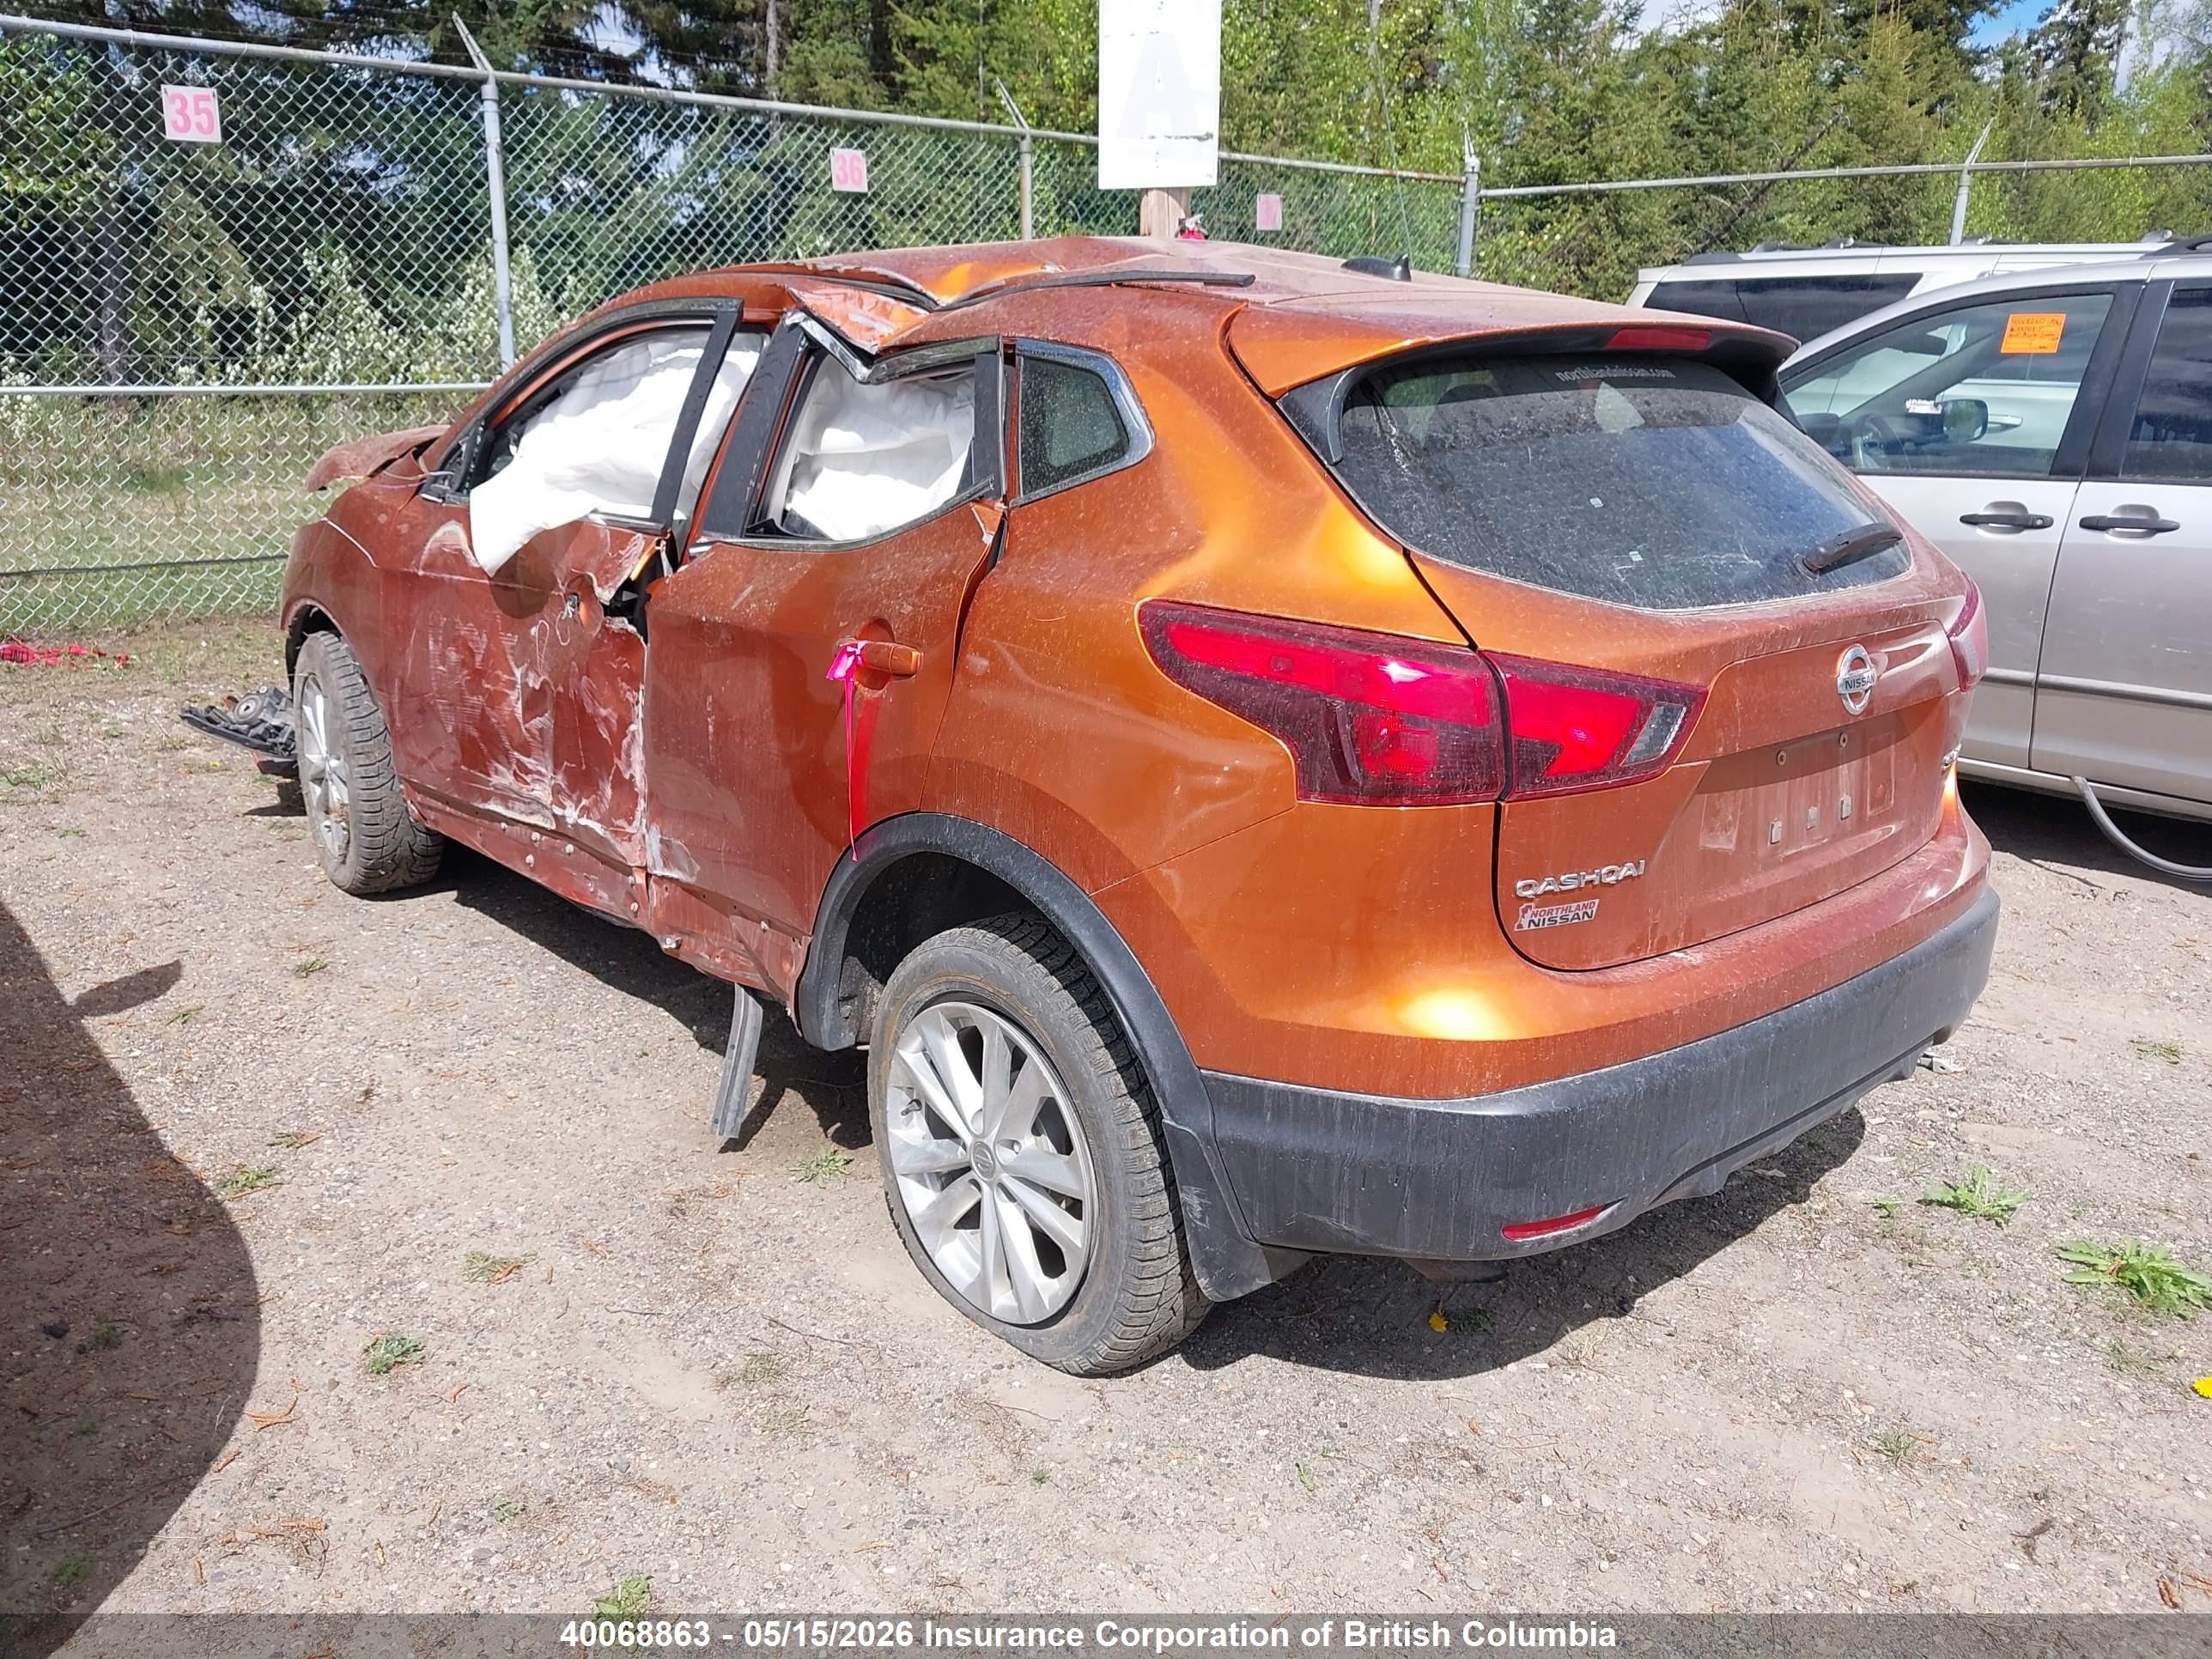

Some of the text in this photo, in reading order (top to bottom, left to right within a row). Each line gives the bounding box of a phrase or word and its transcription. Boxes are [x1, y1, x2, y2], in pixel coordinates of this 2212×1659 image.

[1116, 33, 1202, 138] A
[168, 93, 215, 135] 35
[836, 154, 863, 186] 36
[1844, 674, 1875, 690] NISSAN
[1515, 860, 1646, 899] QASHQAI
[1527, 910, 1595, 929] NISSAN
[1529, 901, 1596, 919] NORTHLAND
